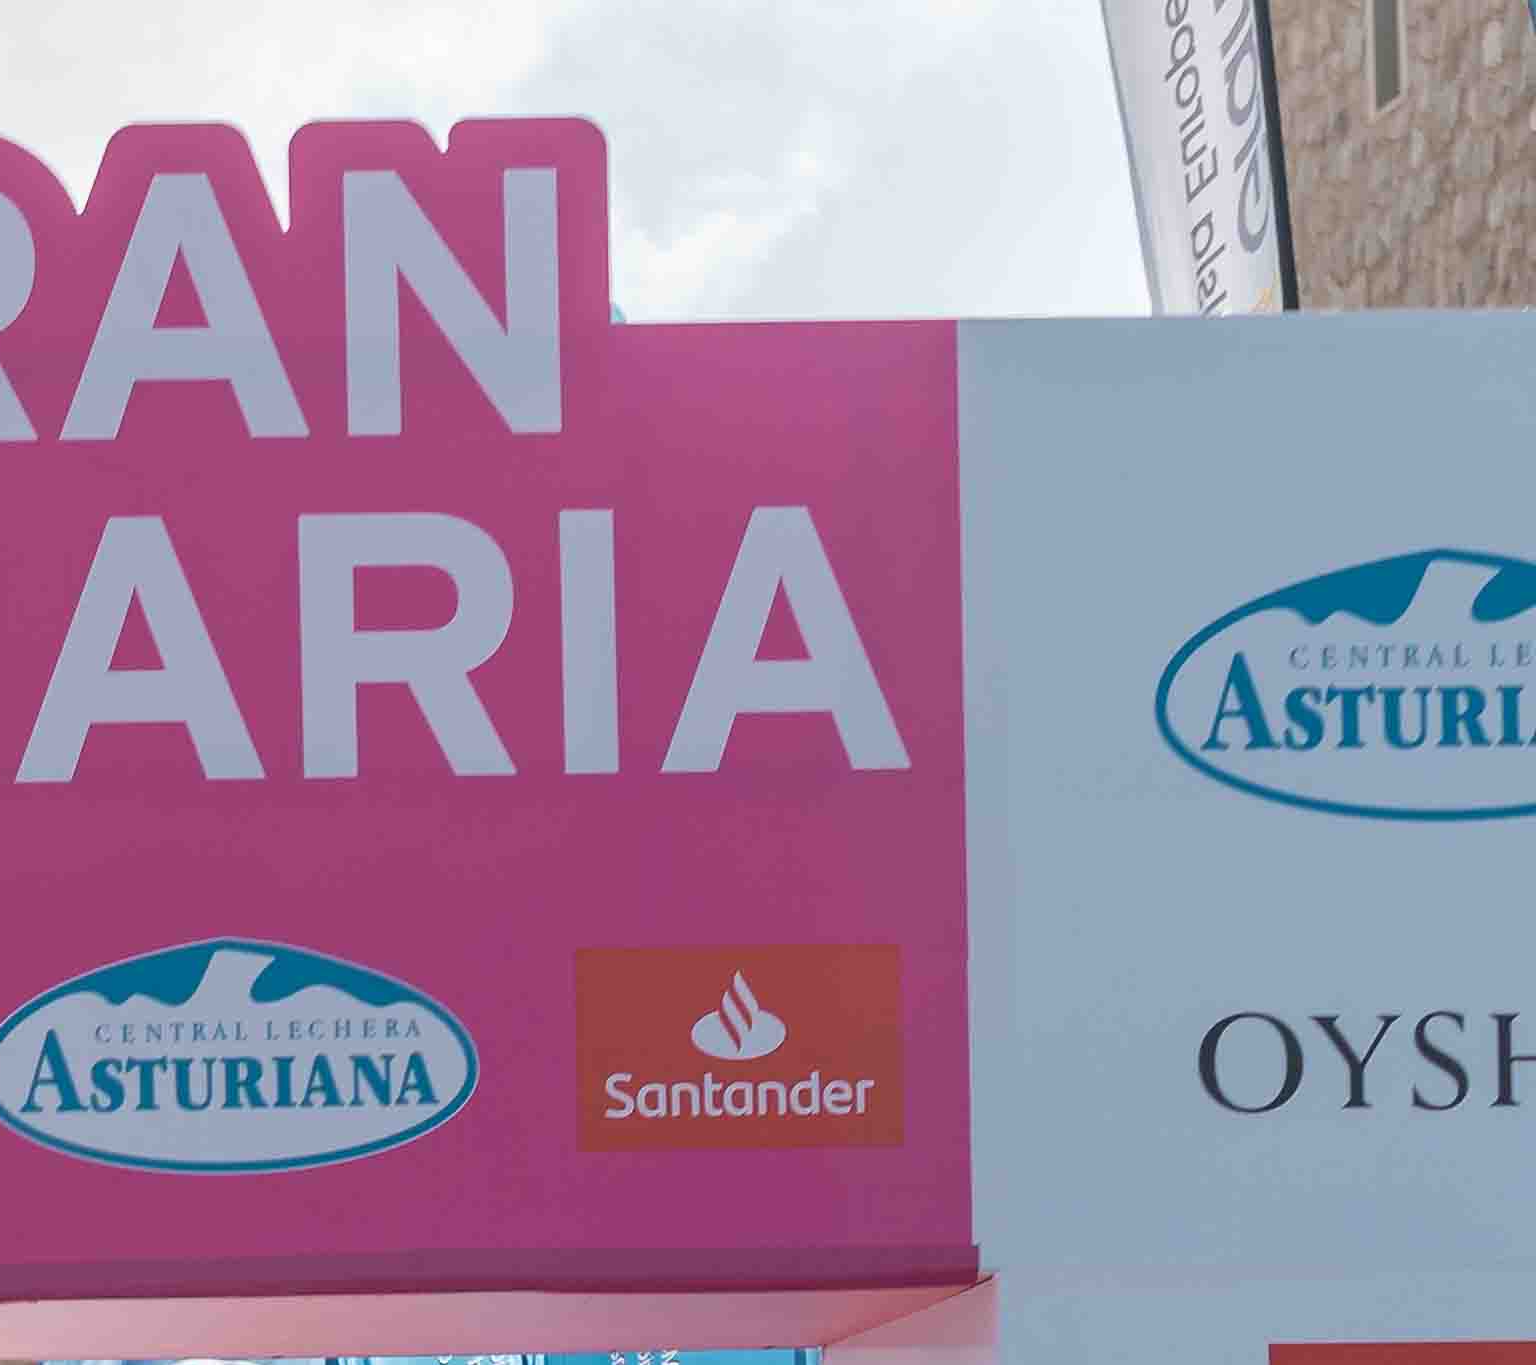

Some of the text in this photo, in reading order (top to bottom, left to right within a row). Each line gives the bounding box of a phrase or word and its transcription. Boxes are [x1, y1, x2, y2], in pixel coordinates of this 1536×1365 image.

[1202, 656, 1536, 755] ASTURI
[95, 1012, 423, 1045] CENTRAL LECHERA
[20, 1044, 439, 1116] ASTURIANA
[604, 1069, 875, 1119] Santander
